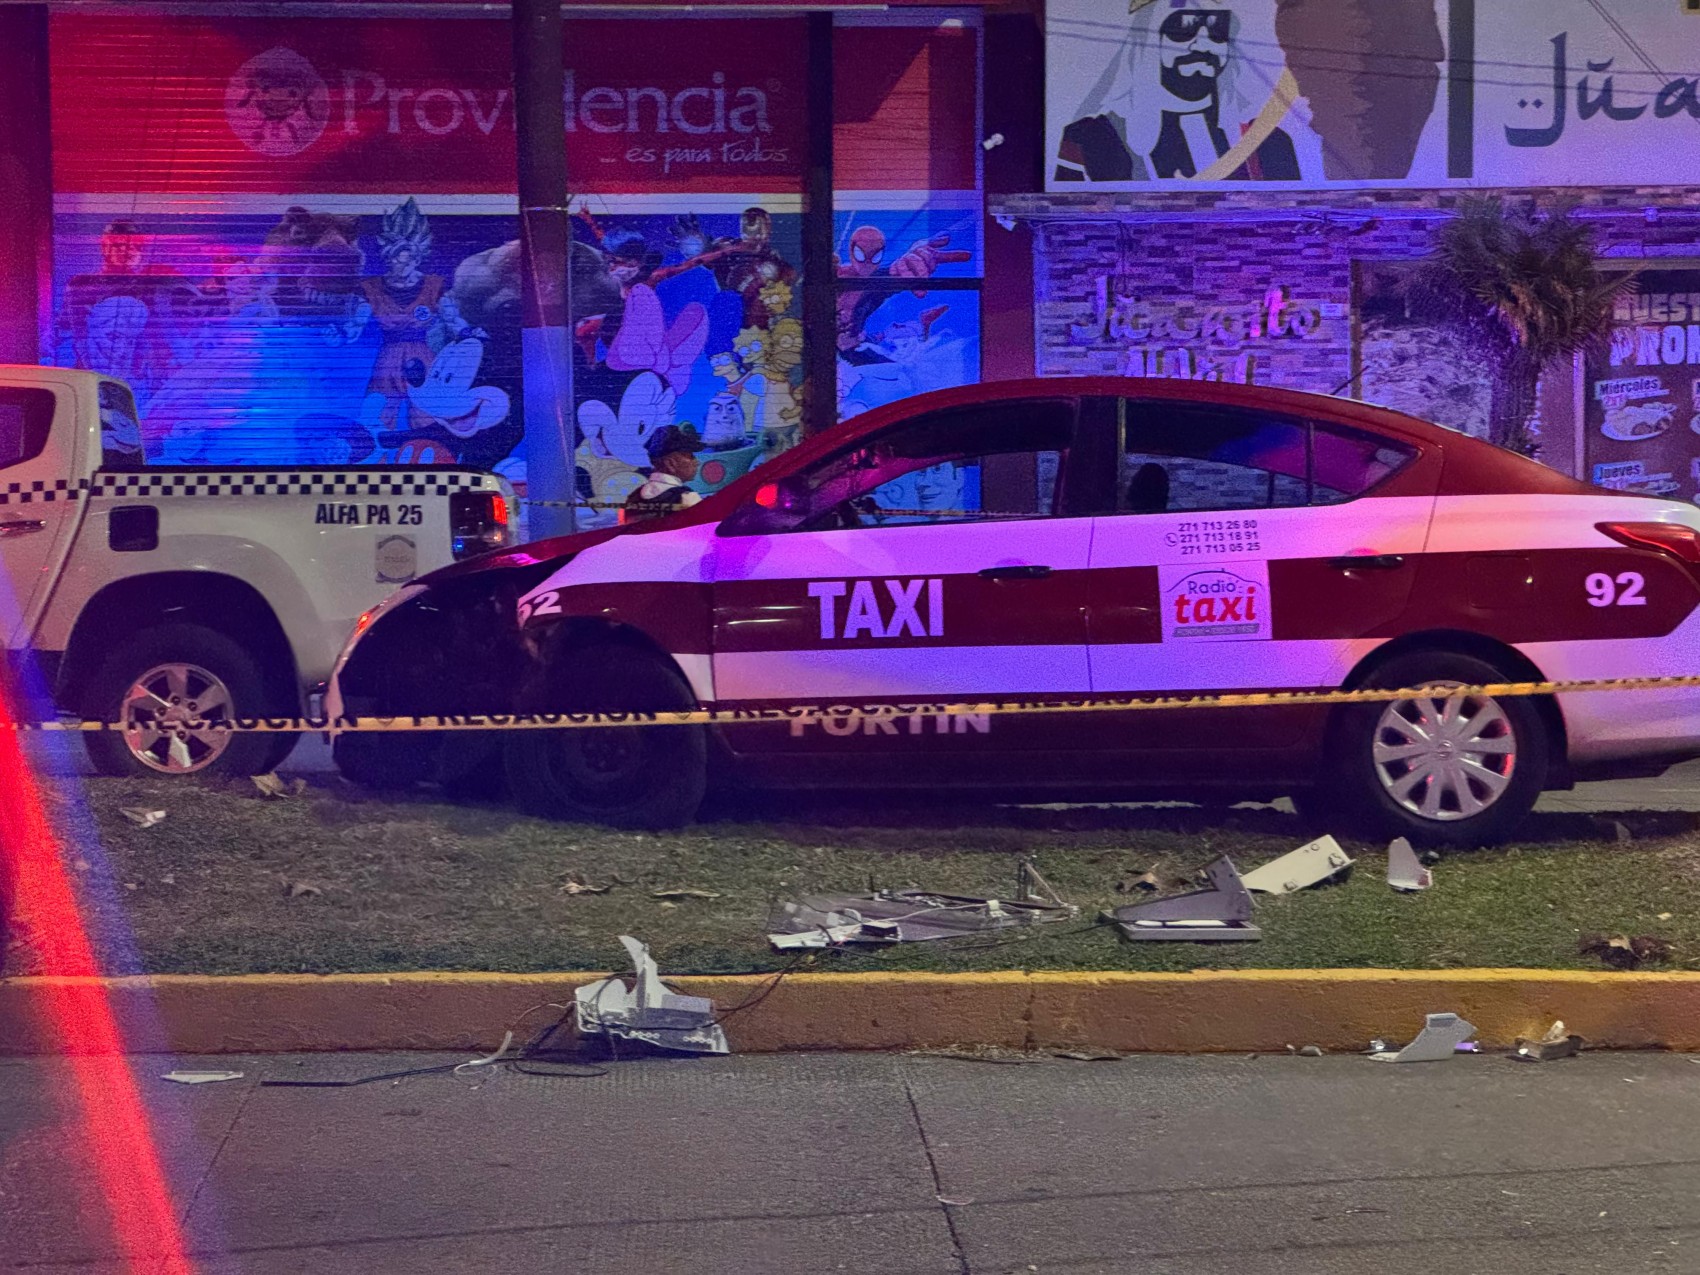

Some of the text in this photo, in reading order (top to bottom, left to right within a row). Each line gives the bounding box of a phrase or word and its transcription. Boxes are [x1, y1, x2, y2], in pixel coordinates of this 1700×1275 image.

[624, 147, 657, 163] es
[663, 148, 711, 174] para
[315, 504, 423, 525] ALFA PA 25
[1178, 522, 1199, 532] 271
[1202, 521, 1223, 531] 713
[1180, 534, 1200, 543] 271
[1204, 533, 1224, 542] 713
[1181, 545, 1201, 555] 271
[1204, 544, 1226, 553] 713
[1246, 542, 1261, 551] 25
[1188, 580, 1236, 594] Radio
[1585, 571, 1647, 607] 92
[807, 578, 944, 639] TAXI
[1174, 586, 1256, 624] taxi
